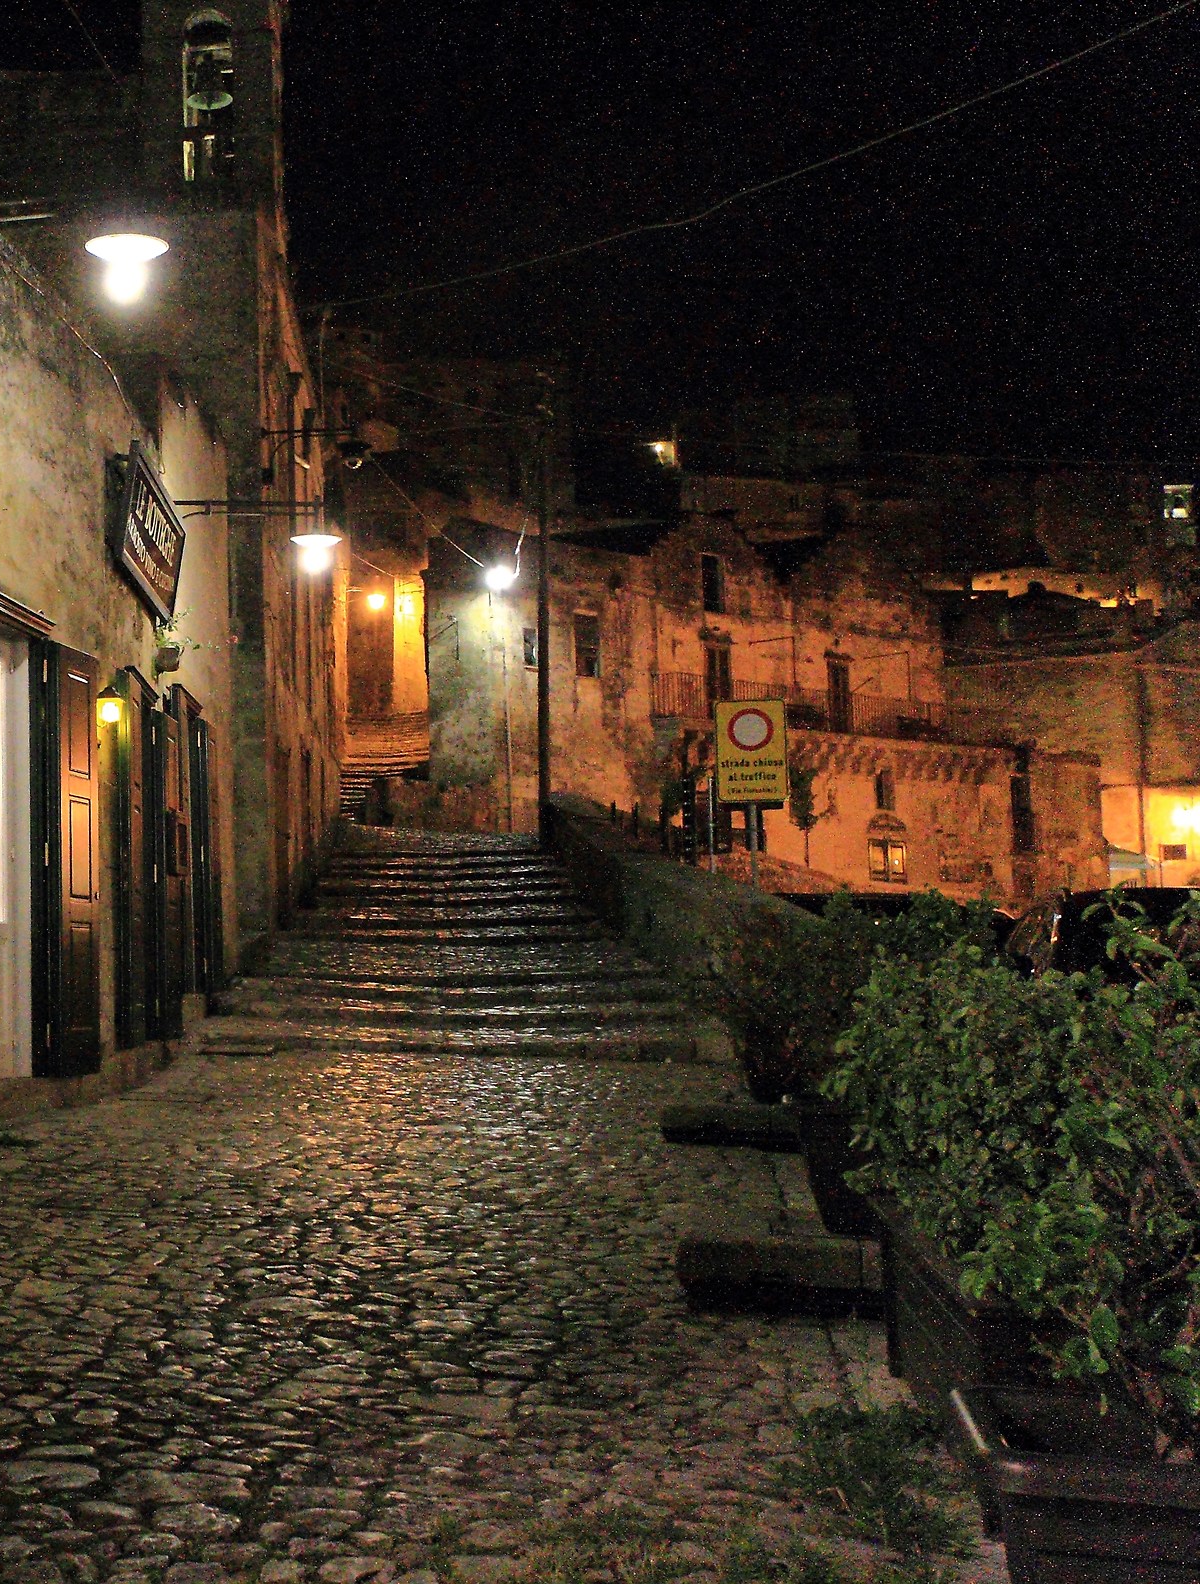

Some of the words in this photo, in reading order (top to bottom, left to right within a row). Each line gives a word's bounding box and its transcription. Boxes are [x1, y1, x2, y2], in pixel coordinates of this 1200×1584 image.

[135, 480, 147, 522] LE
[144, 494, 177, 567] BOTTEGHE
[721, 758, 750, 769] strada
[753, 757, 784, 767] chiusa
[728, 772, 738, 781] al
[741, 771, 777, 781] traffico
